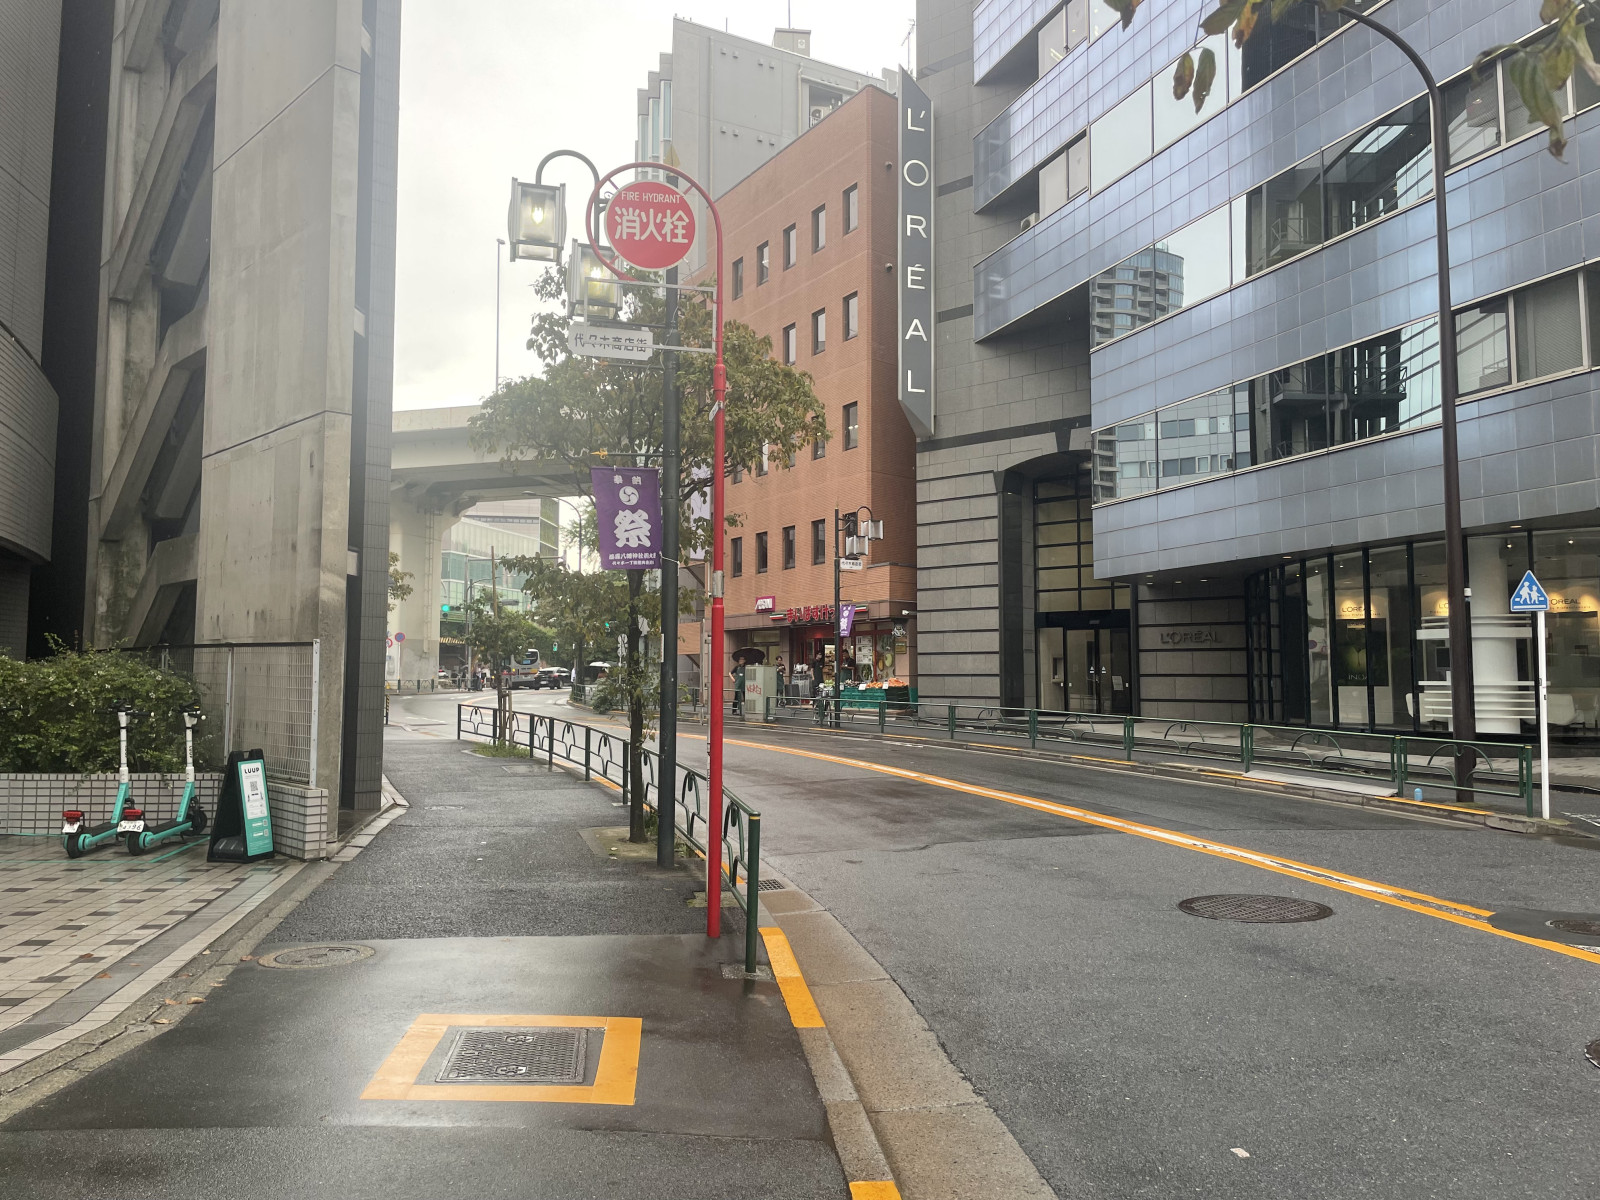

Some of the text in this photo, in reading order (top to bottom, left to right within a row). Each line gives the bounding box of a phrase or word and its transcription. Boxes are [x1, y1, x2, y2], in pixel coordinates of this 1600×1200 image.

[621, 191, 681, 204] FIRE HYDRANT
[614, 206, 690, 244] 消火栓
[902, 107, 930, 393] L'ORÉAL
[613, 509, 652, 548] 祭
